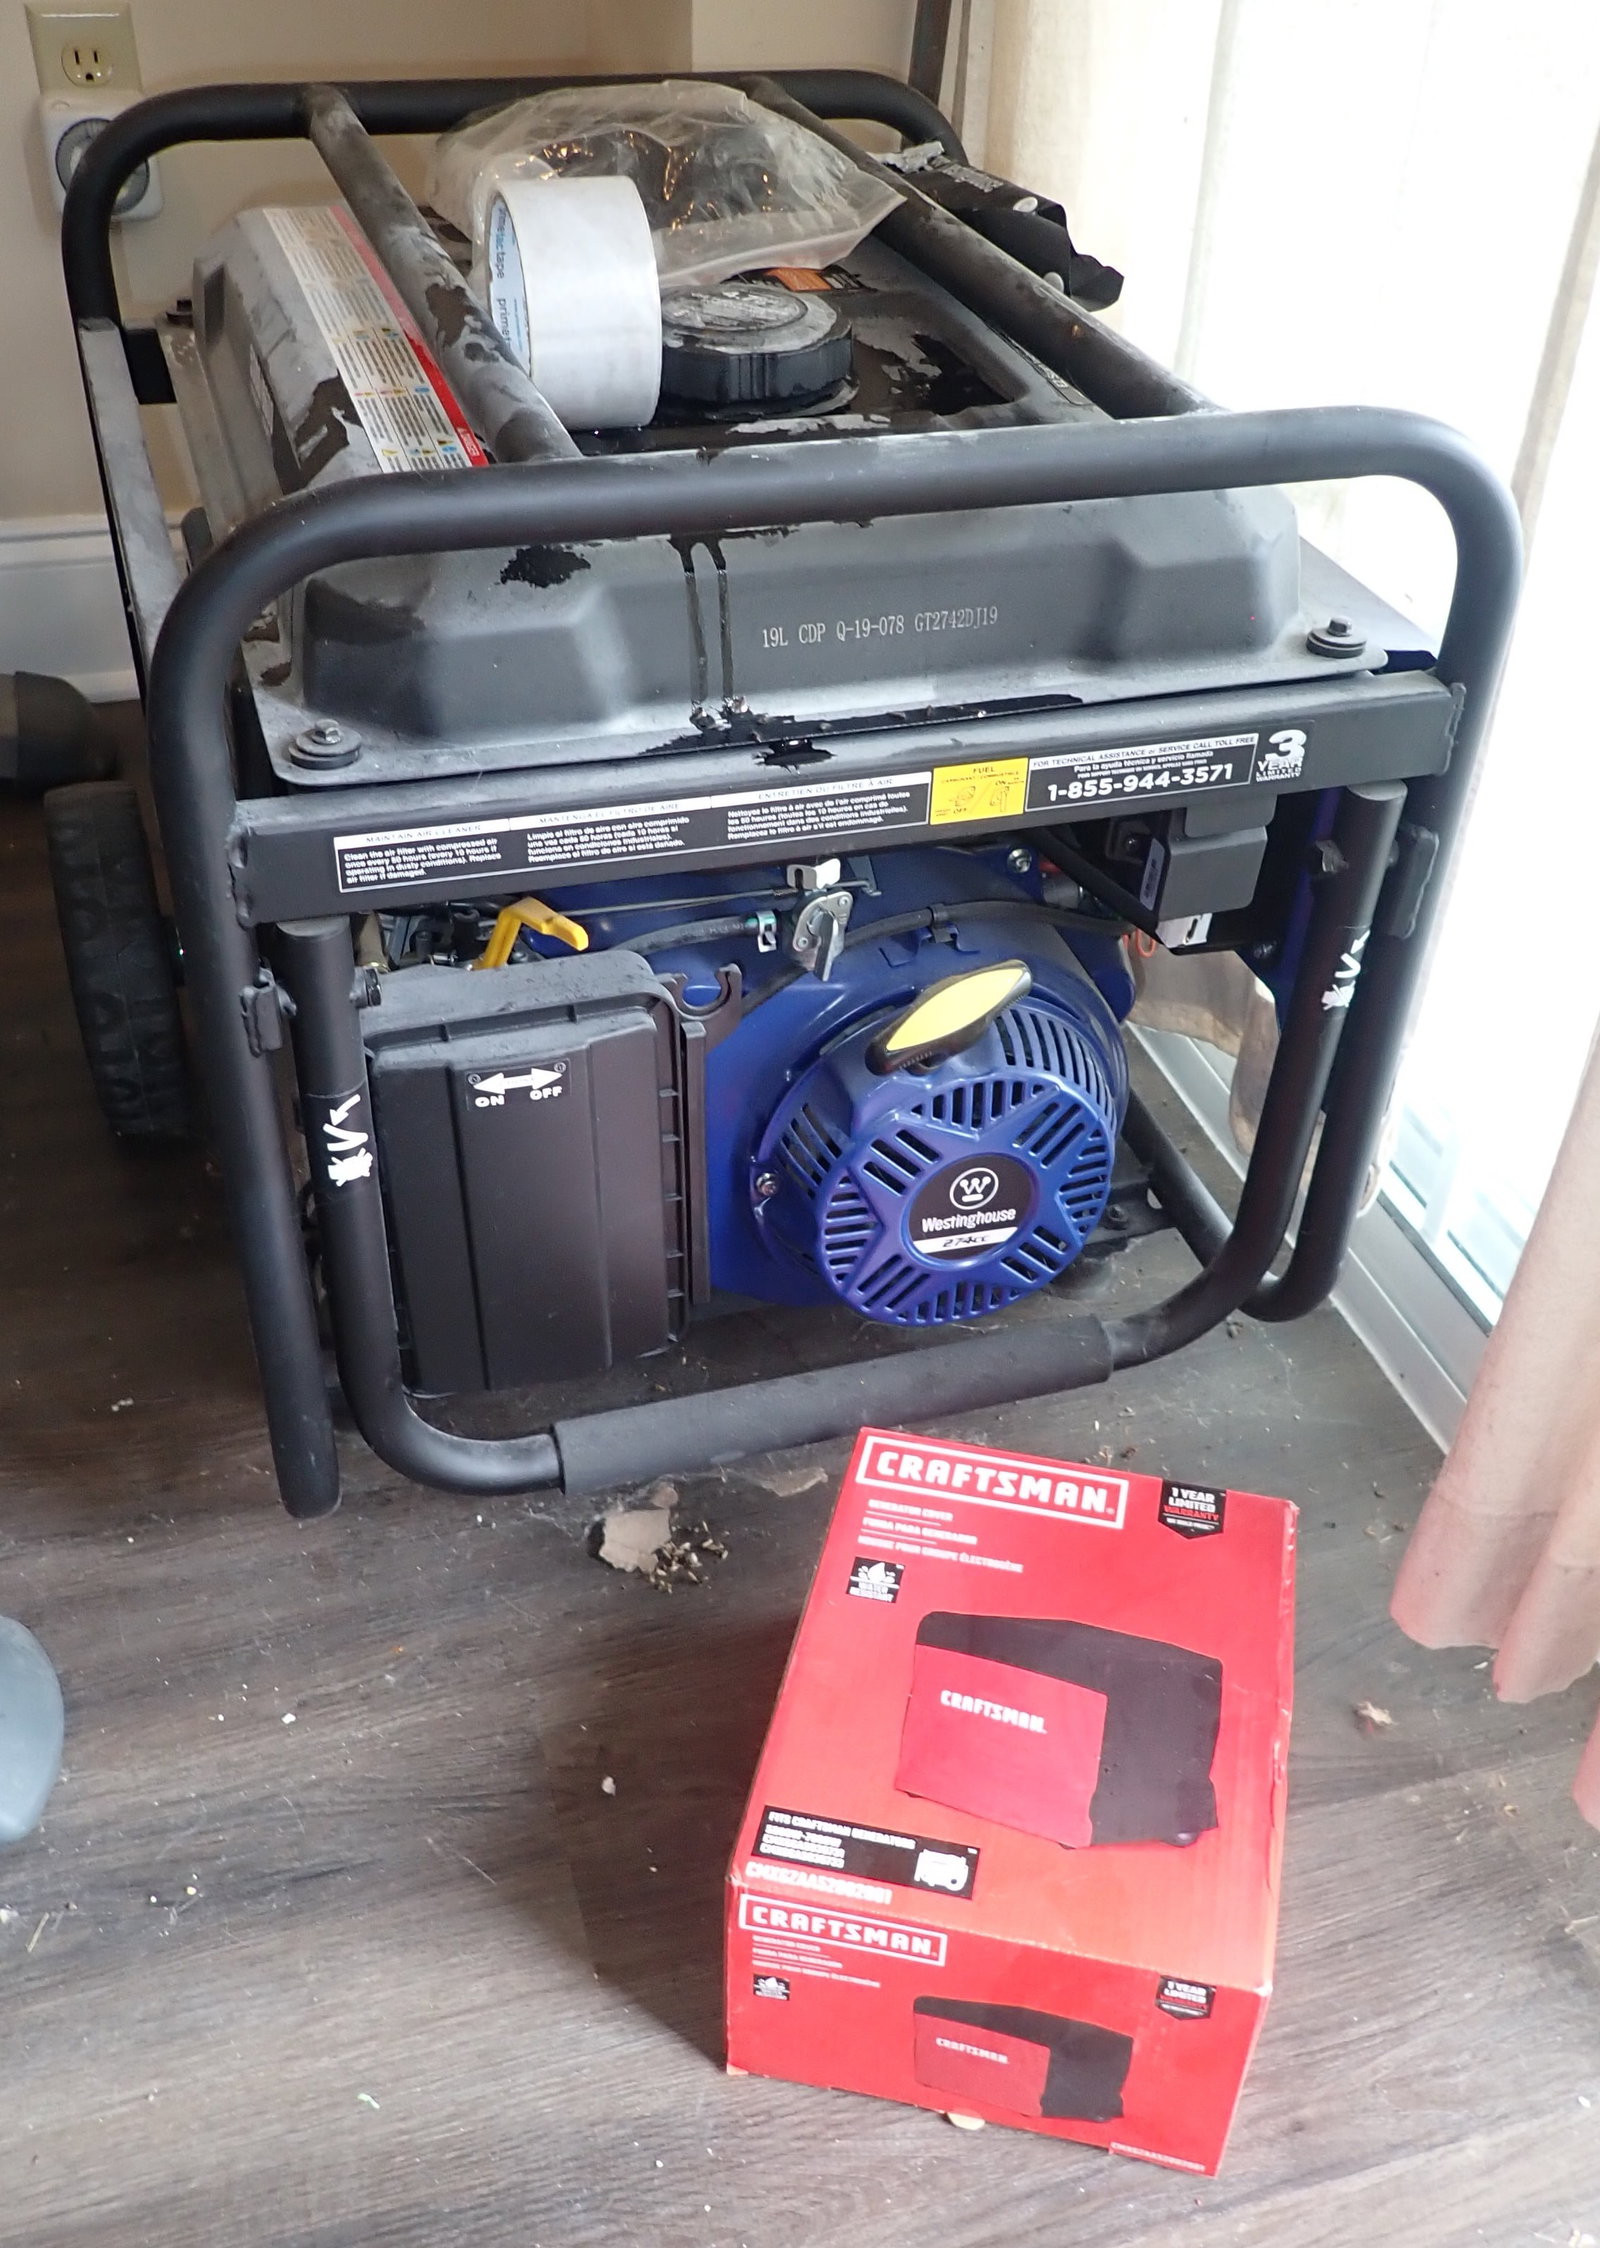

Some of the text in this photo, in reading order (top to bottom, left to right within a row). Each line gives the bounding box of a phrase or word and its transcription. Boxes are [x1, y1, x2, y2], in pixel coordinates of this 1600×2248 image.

[496, 252, 507, 279] tape
[763, 628, 788, 647] 19L
[799, 623, 825, 644] CDP
[837, 615, 904, 641] Q-19-078
[1052, 754, 1094, 764] TECHNICAL
[1099, 748, 1144, 762] ASSISTANCE
[1158, 744, 1189, 752] SERVICE
[1193, 741, 1211, 749] CALL
[1215, 738, 1232, 746] TOLL
[1265, 729, 1307, 759] 3
[1074, 764, 1090, 772] Para
[1257, 756, 1302, 772] YEAR
[1048, 763, 1233, 801] 1-855-944-3571
[475, 1095, 505, 1107] ON
[529, 1086, 562, 1100] OFF
[922, 1208, 1017, 1233] Westinghouse
[876, 1451, 1109, 1514] CRAFTSMAN
[1171, 1487, 1215, 1504] 1 YEAR
[1168, 1496, 1216, 1513] LIMITED
[940, 1690, 1045, 1733] CRAFTSMAN
[752, 1905, 932, 1956] CRAFTSMAN
